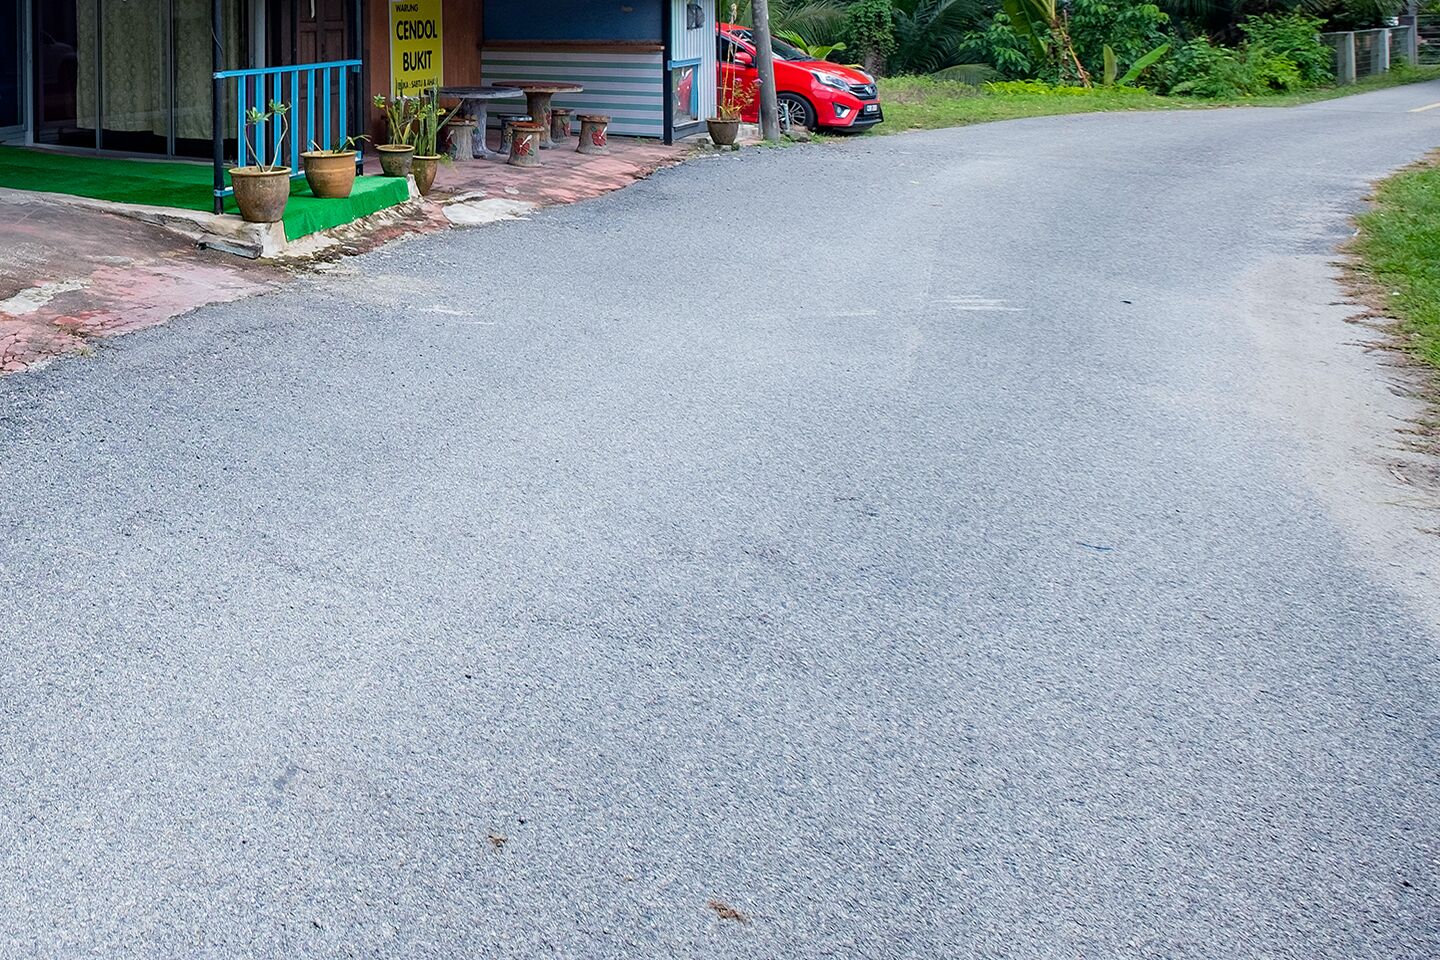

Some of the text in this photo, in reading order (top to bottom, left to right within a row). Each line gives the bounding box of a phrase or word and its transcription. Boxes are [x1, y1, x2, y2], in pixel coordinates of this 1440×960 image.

[395, 3, 419, 12] WARUNG
[396, 19, 438, 40] CENDOL
[403, 50, 433, 71] BUKIT
